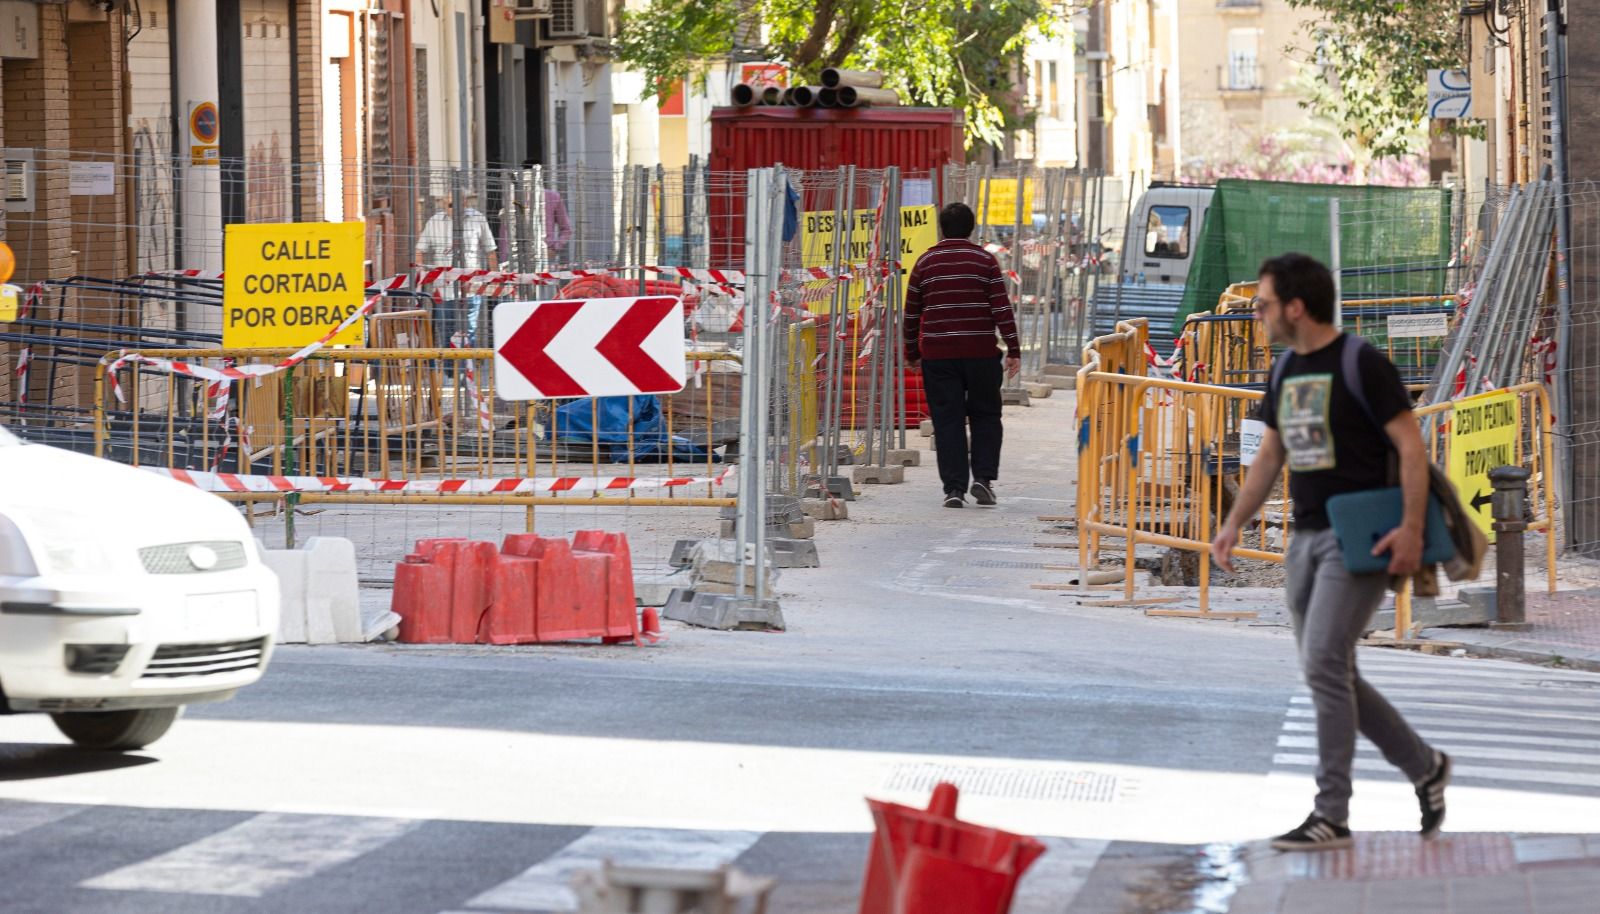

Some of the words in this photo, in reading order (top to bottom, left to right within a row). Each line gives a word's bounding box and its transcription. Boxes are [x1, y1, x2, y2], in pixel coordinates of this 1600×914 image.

[261, 240, 331, 260] CALLE
[244, 272, 347, 294] CORTADA
[230, 308, 276, 327] POR
[283, 305, 357, 326] OBRAS
